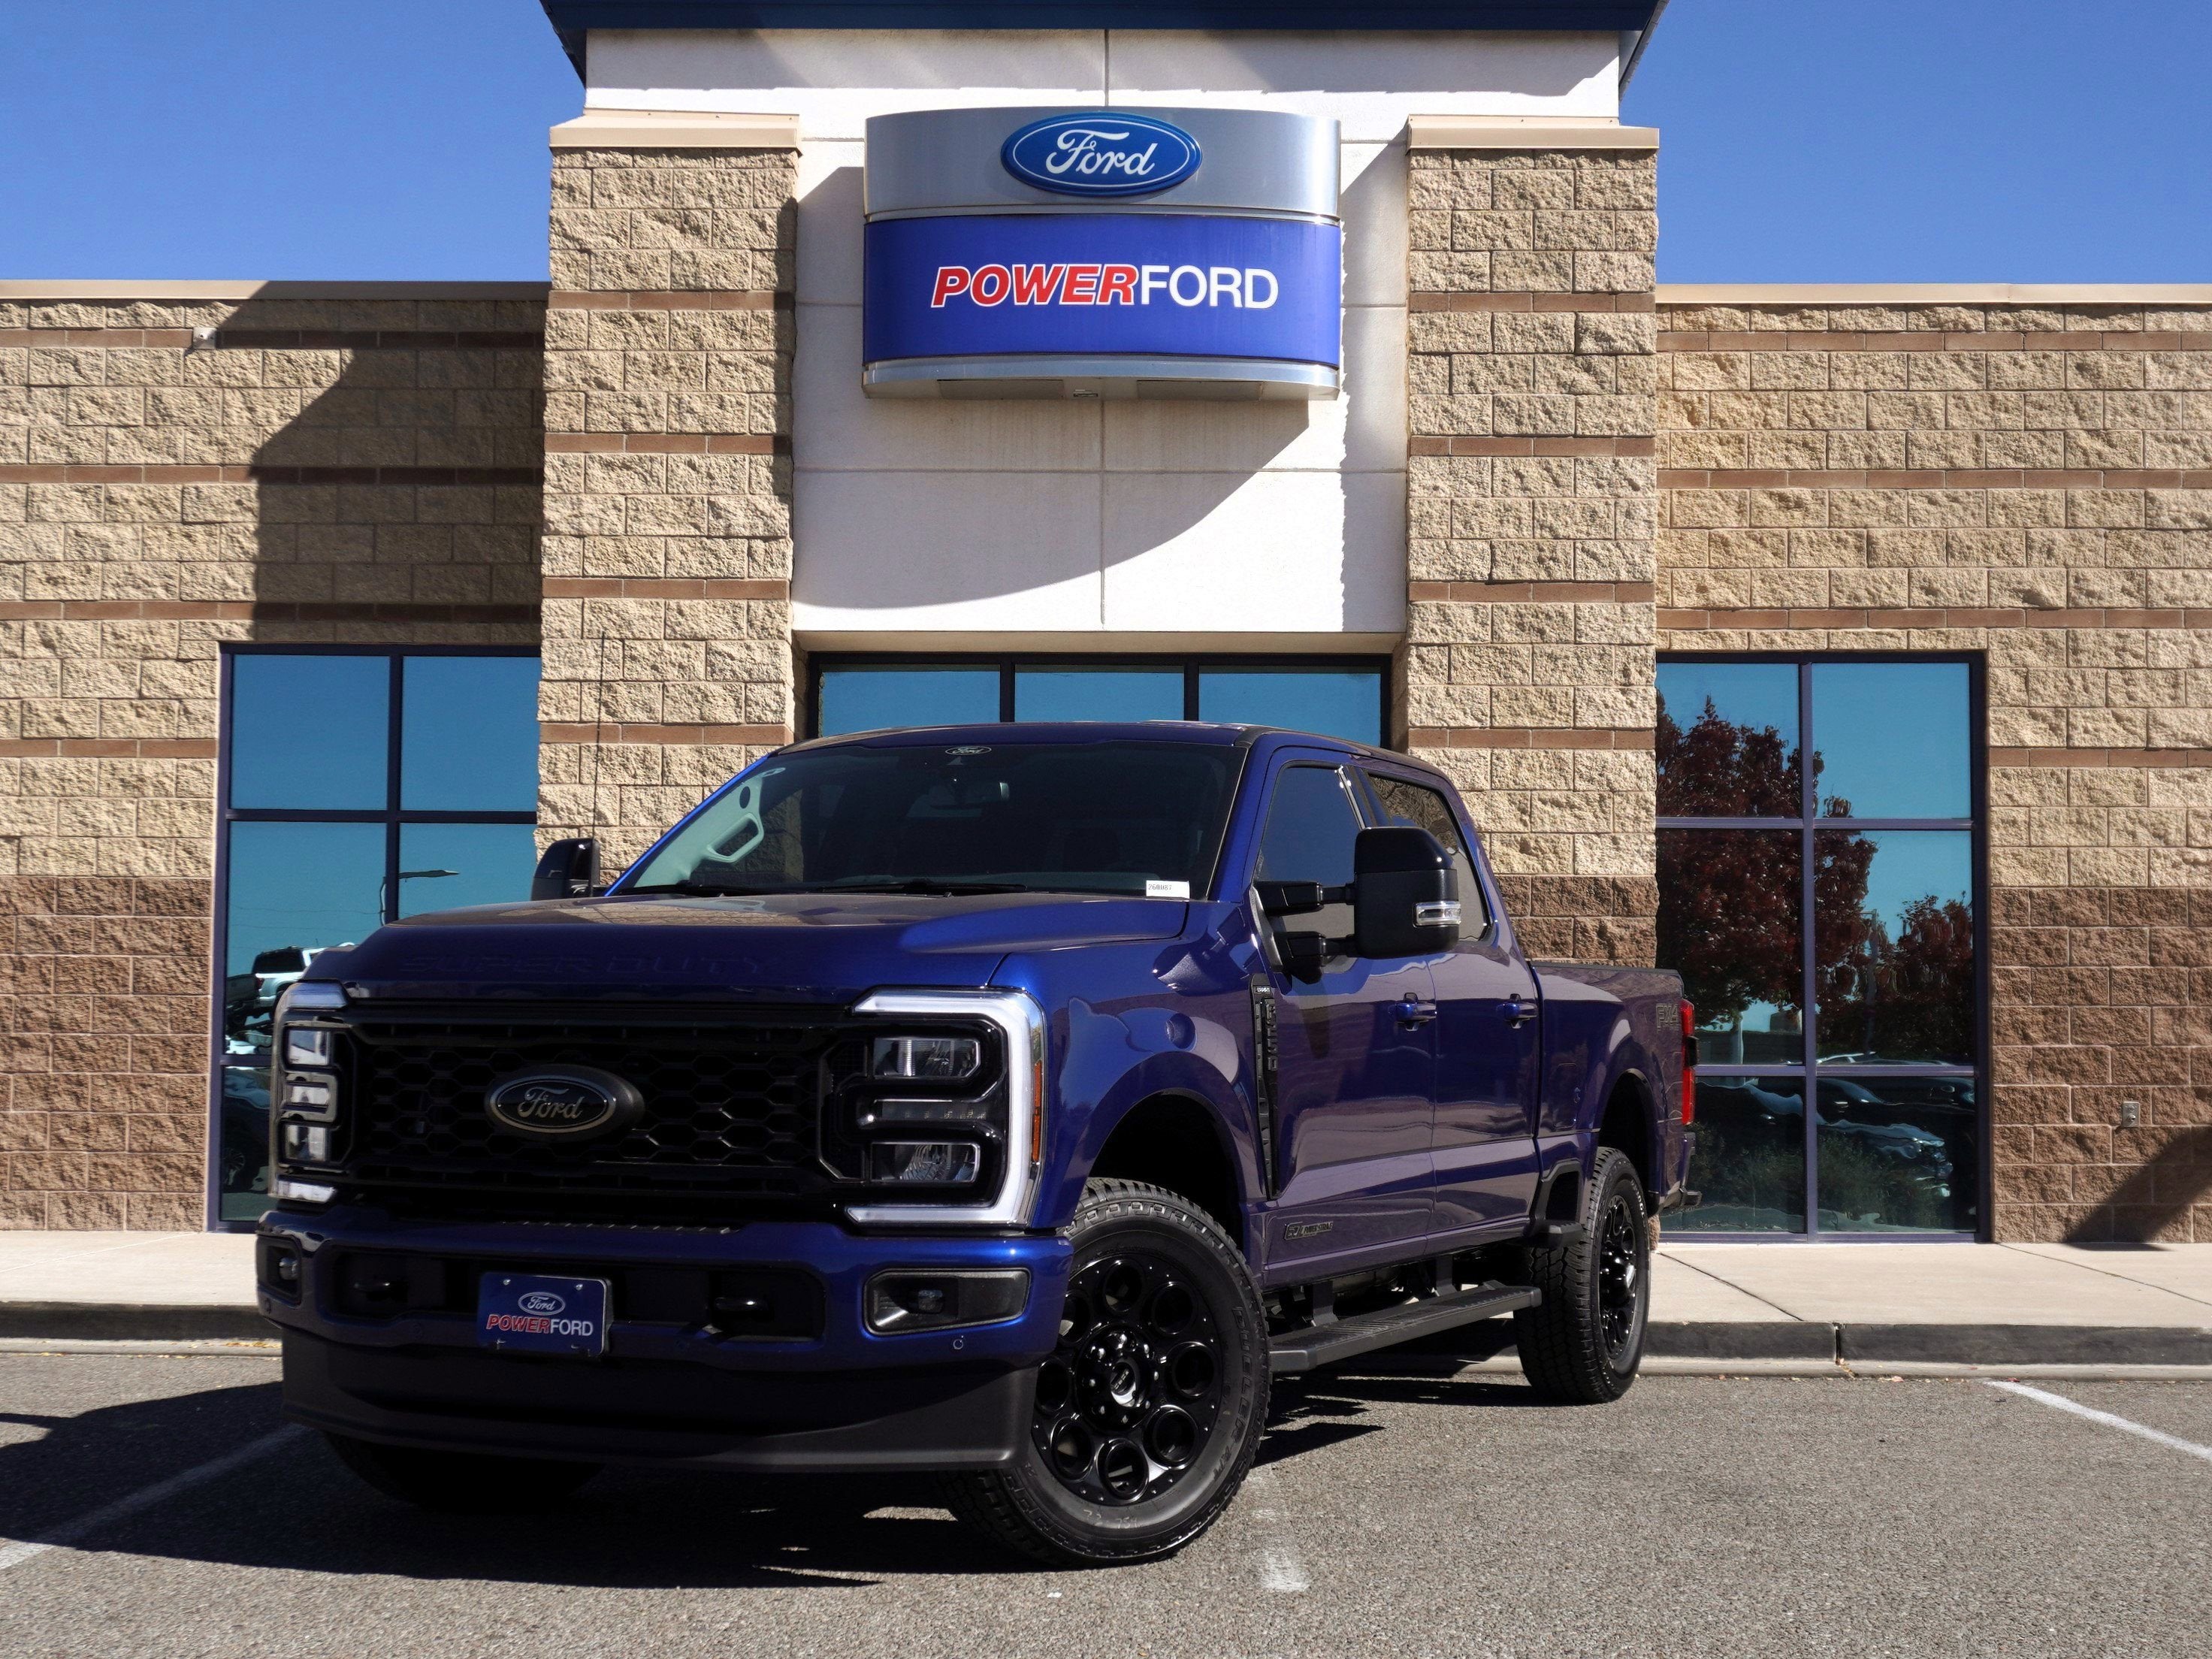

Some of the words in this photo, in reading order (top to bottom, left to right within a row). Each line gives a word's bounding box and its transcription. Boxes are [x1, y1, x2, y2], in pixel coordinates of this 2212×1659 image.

[1045, 128, 1159, 176] Ford
[606, 954, 780, 976] DUTY
[516, 1086, 586, 1120] Ford
[527, 1295, 555, 1311] Ford
